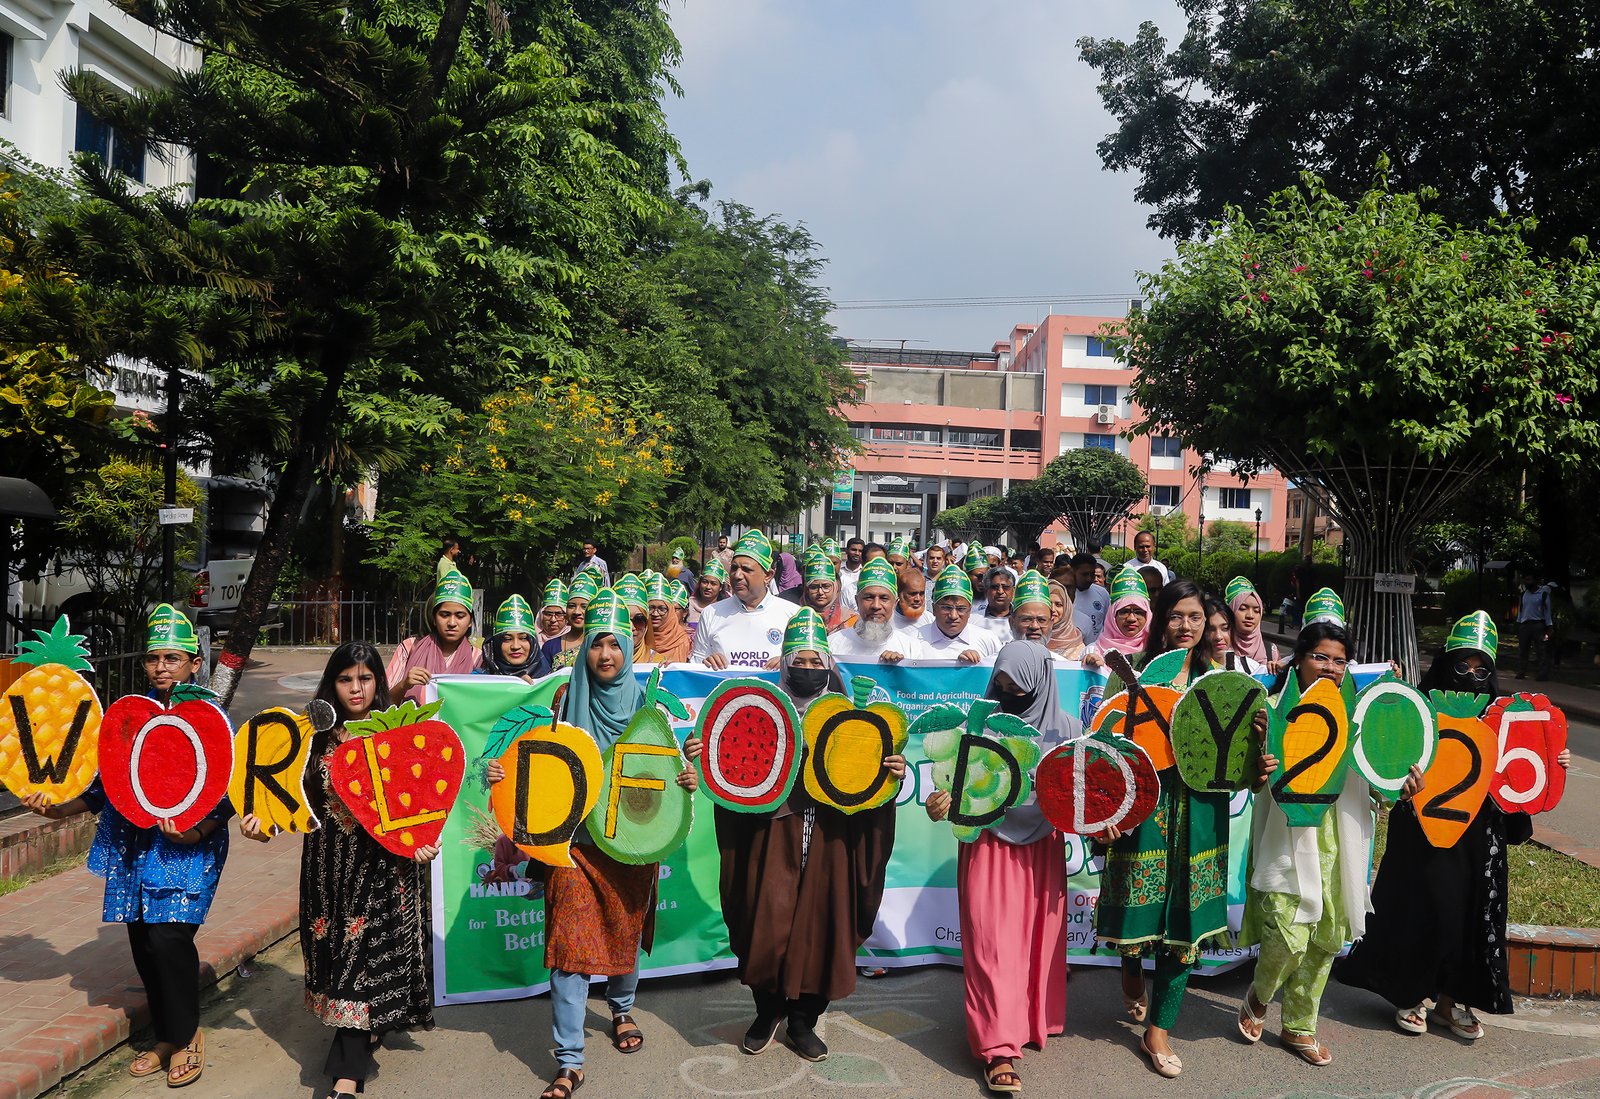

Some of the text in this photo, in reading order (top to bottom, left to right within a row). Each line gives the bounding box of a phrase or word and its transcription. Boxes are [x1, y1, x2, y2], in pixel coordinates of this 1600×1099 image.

[730, 652, 770, 660] WORLD
[896, 690, 916, 700] Food
[918, 692, 934, 700] and
[936, 690, 981, 702] Agriculture
[470, 881, 530, 898] HAND
[469, 918, 486, 930] for
